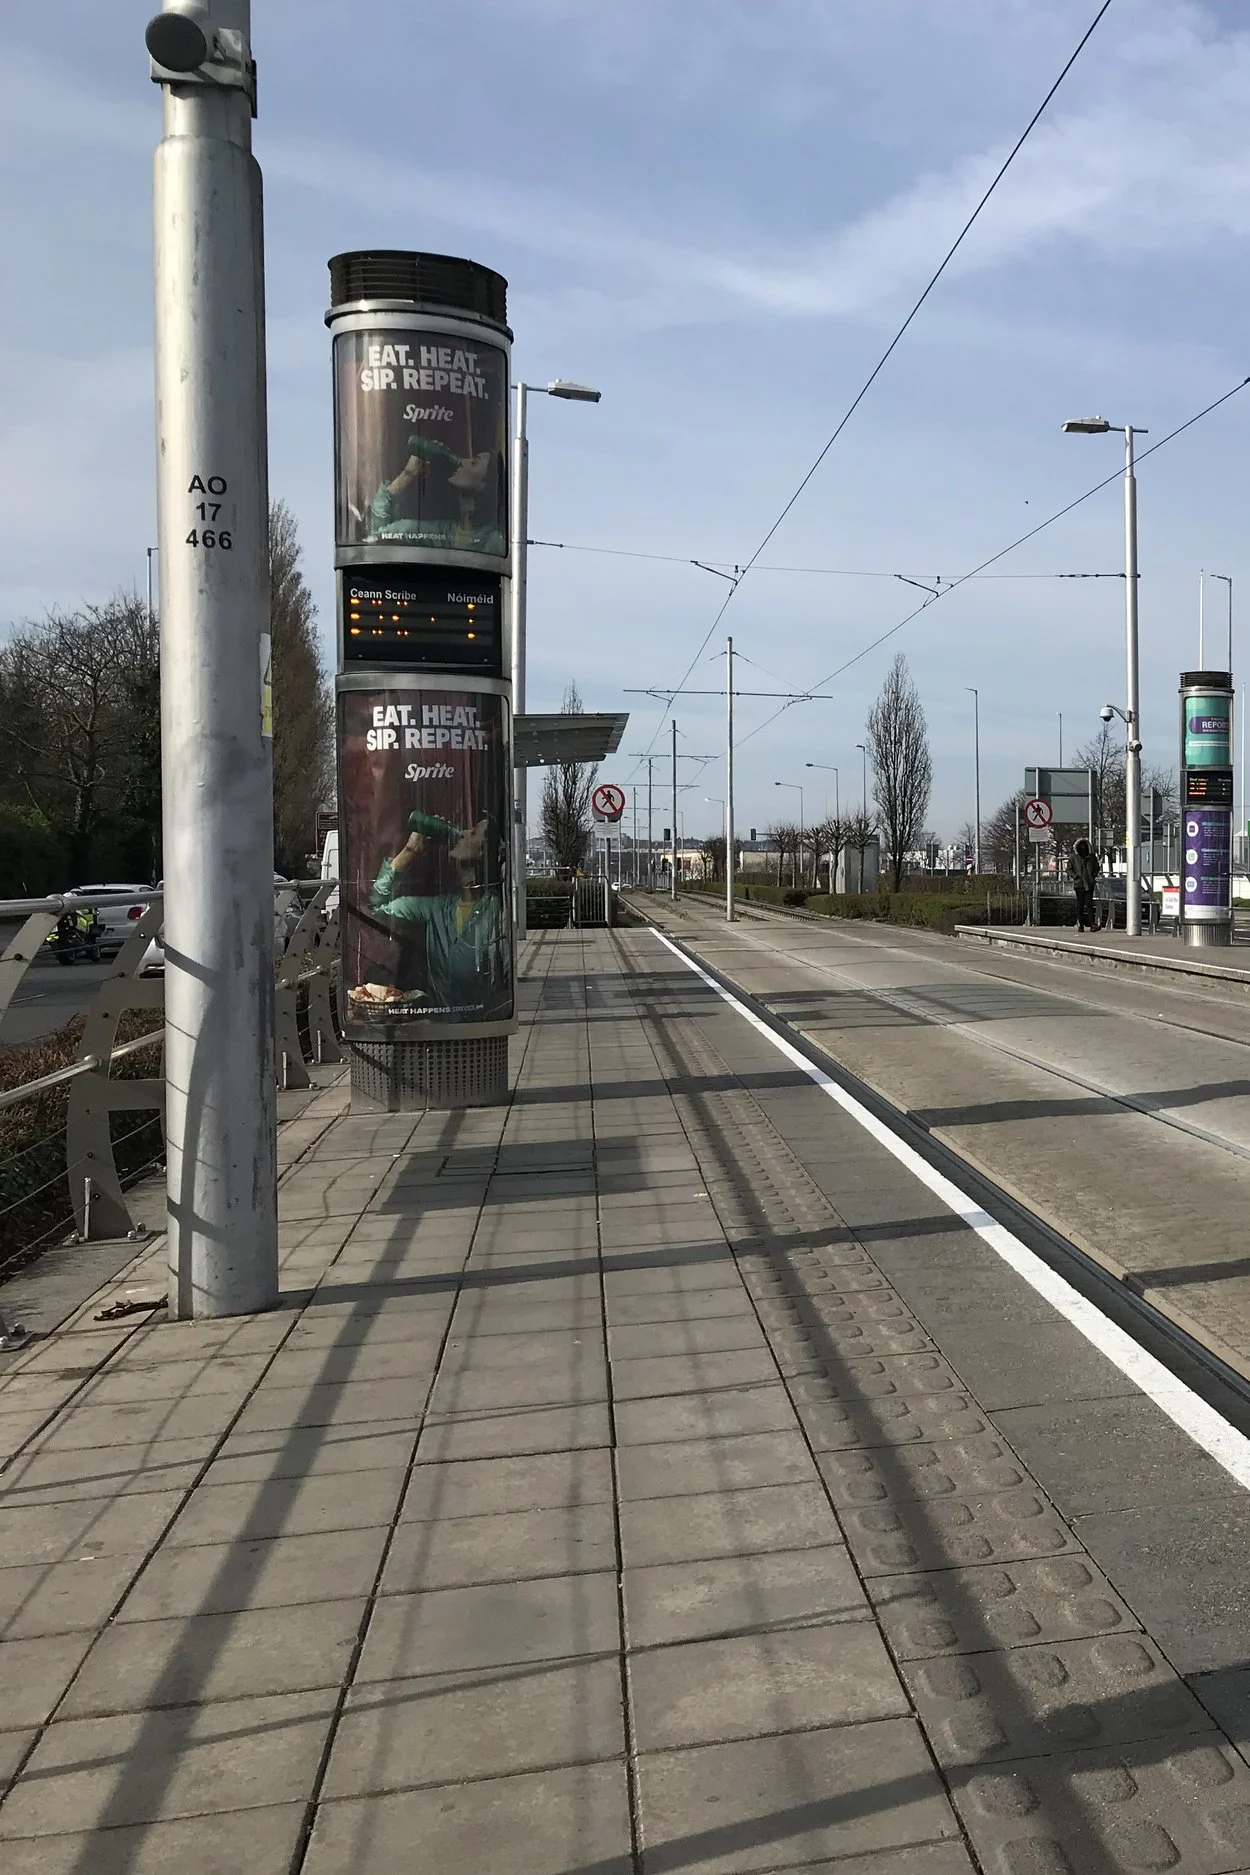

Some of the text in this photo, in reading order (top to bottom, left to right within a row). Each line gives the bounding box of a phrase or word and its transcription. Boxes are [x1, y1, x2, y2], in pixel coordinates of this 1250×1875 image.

[368, 344, 481, 375] EAT. HEAT.
[360, 368, 489, 400] SIP. REPEAT.
[403, 404, 454, 423] Sprite
[187, 474, 227, 495] AO
[196, 502, 222, 521] 17
[185, 529, 232, 550] 466
[350, 588, 494, 604] Ceann Scribe Nóiméid
[373, 705, 480, 728] EAT. HEAT.
[366, 728, 488, 751] SIP. REPEAT.
[404, 763, 455, 782] Sprite
